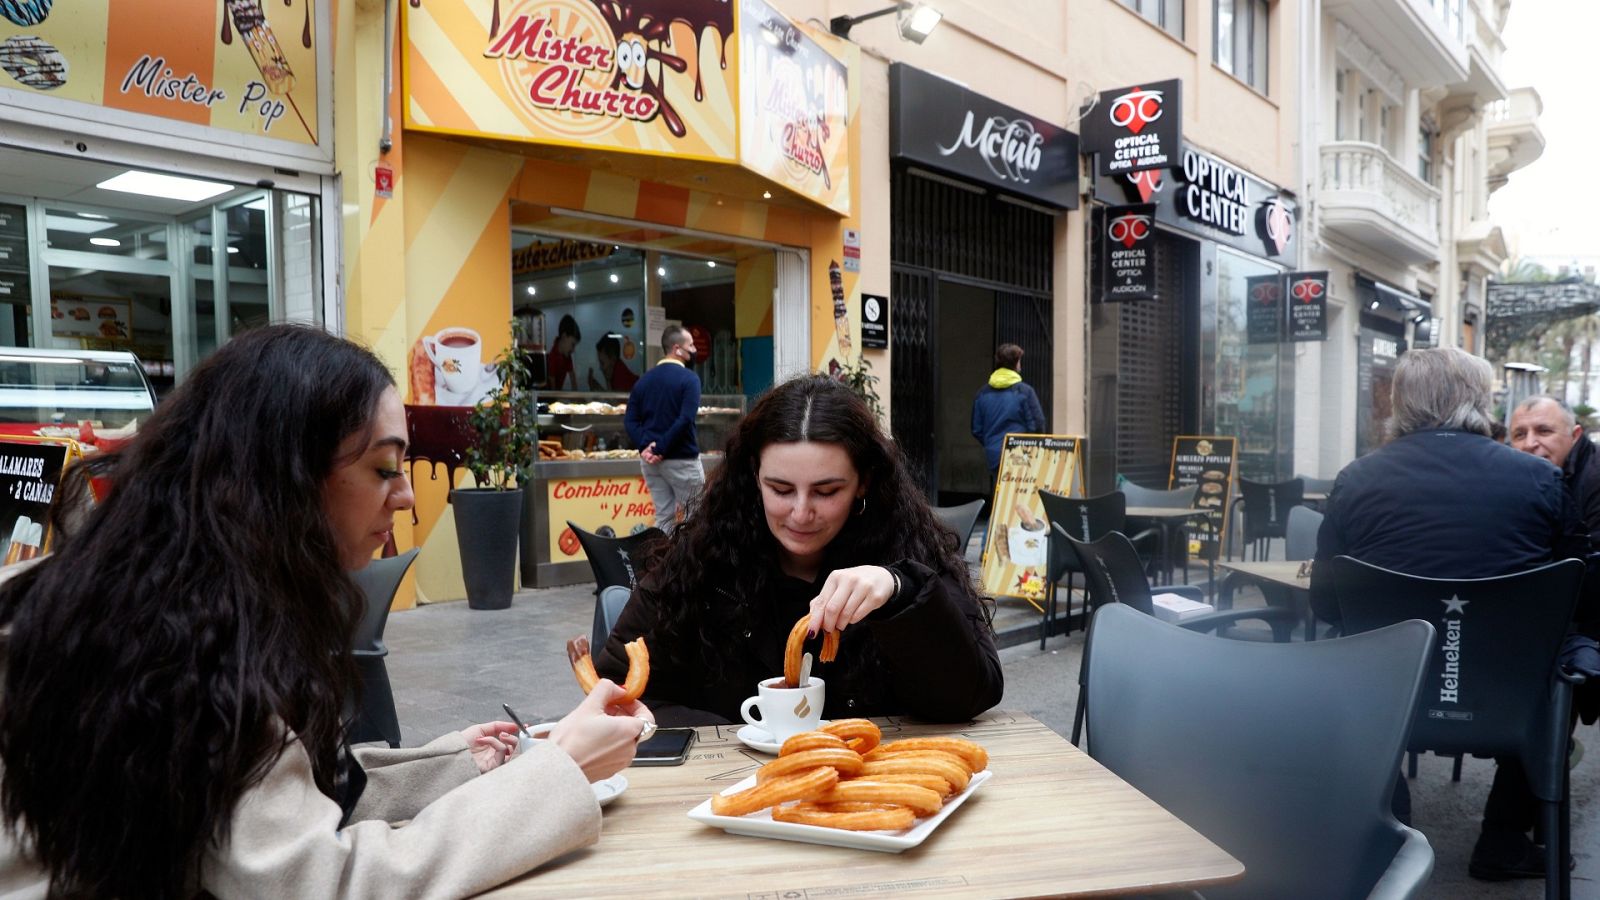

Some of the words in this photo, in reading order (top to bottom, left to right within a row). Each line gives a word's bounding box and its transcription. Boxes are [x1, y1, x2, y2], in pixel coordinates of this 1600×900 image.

[488, 14, 614, 70] Mister
[121, 55, 226, 106] Mister
[239, 81, 286, 131] Pop
[529, 65, 656, 119] Churro
[782, 121, 823, 171] Churro
[1114, 133, 1160, 149] OPTICAL
[1114, 144, 1160, 160] CENTER
[1184, 150, 1251, 207] OPTICAL
[1187, 184, 1248, 235] CENTER
[1111, 249, 1147, 260] OPTICAL
[1111, 258, 1147, 268] CENTER
[14, 480, 23, 499] 2
[553, 478, 631, 500] Combina
[1440, 618, 1461, 703] Heineken
